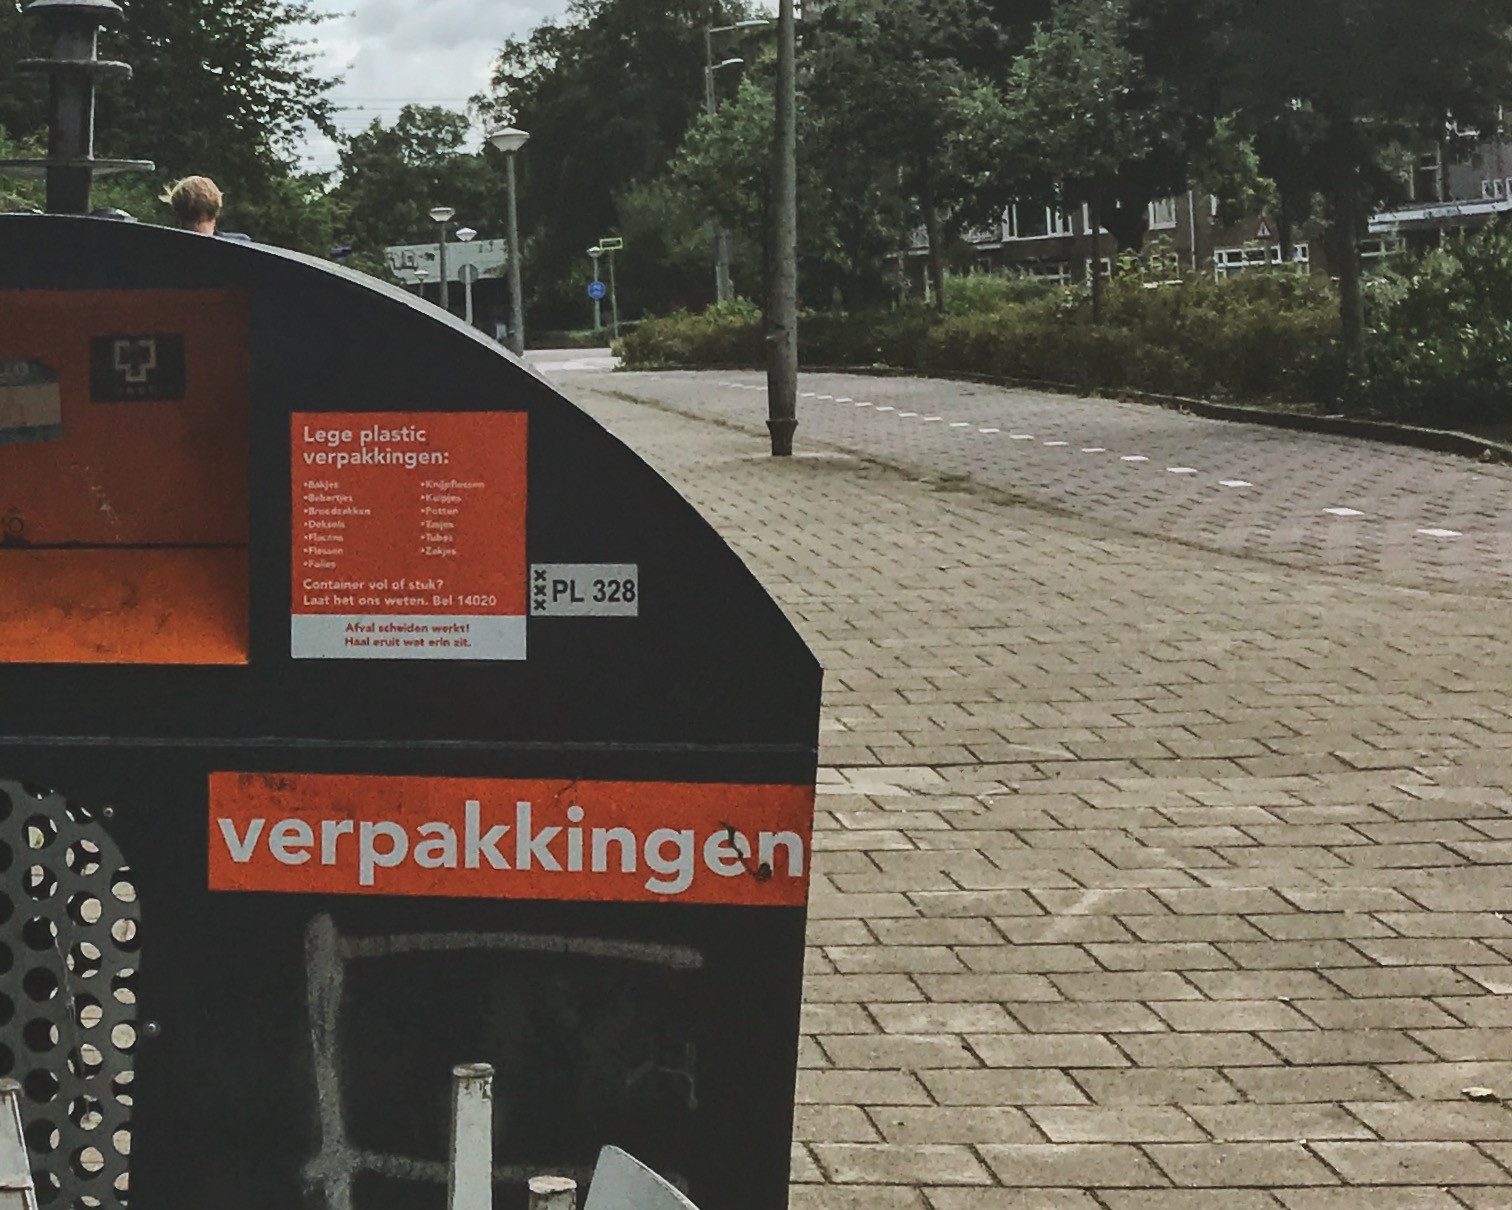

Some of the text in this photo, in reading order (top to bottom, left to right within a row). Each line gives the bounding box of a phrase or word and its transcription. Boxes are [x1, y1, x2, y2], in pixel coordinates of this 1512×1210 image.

[303, 425, 426, 444] Lege plastic
[303, 446, 450, 469] verpakkingen:
[302, 578, 444, 591] Container vol of stuk?
[552, 579, 636, 603] PL 328
[303, 594, 497, 607] Laat het ons weten. Bel 14020
[345, 622, 470, 633] Afval scheiden werkt!
[344, 636, 472, 648] Haal eruit wat erin zit.
[217, 798, 804, 895] verpakkingen
